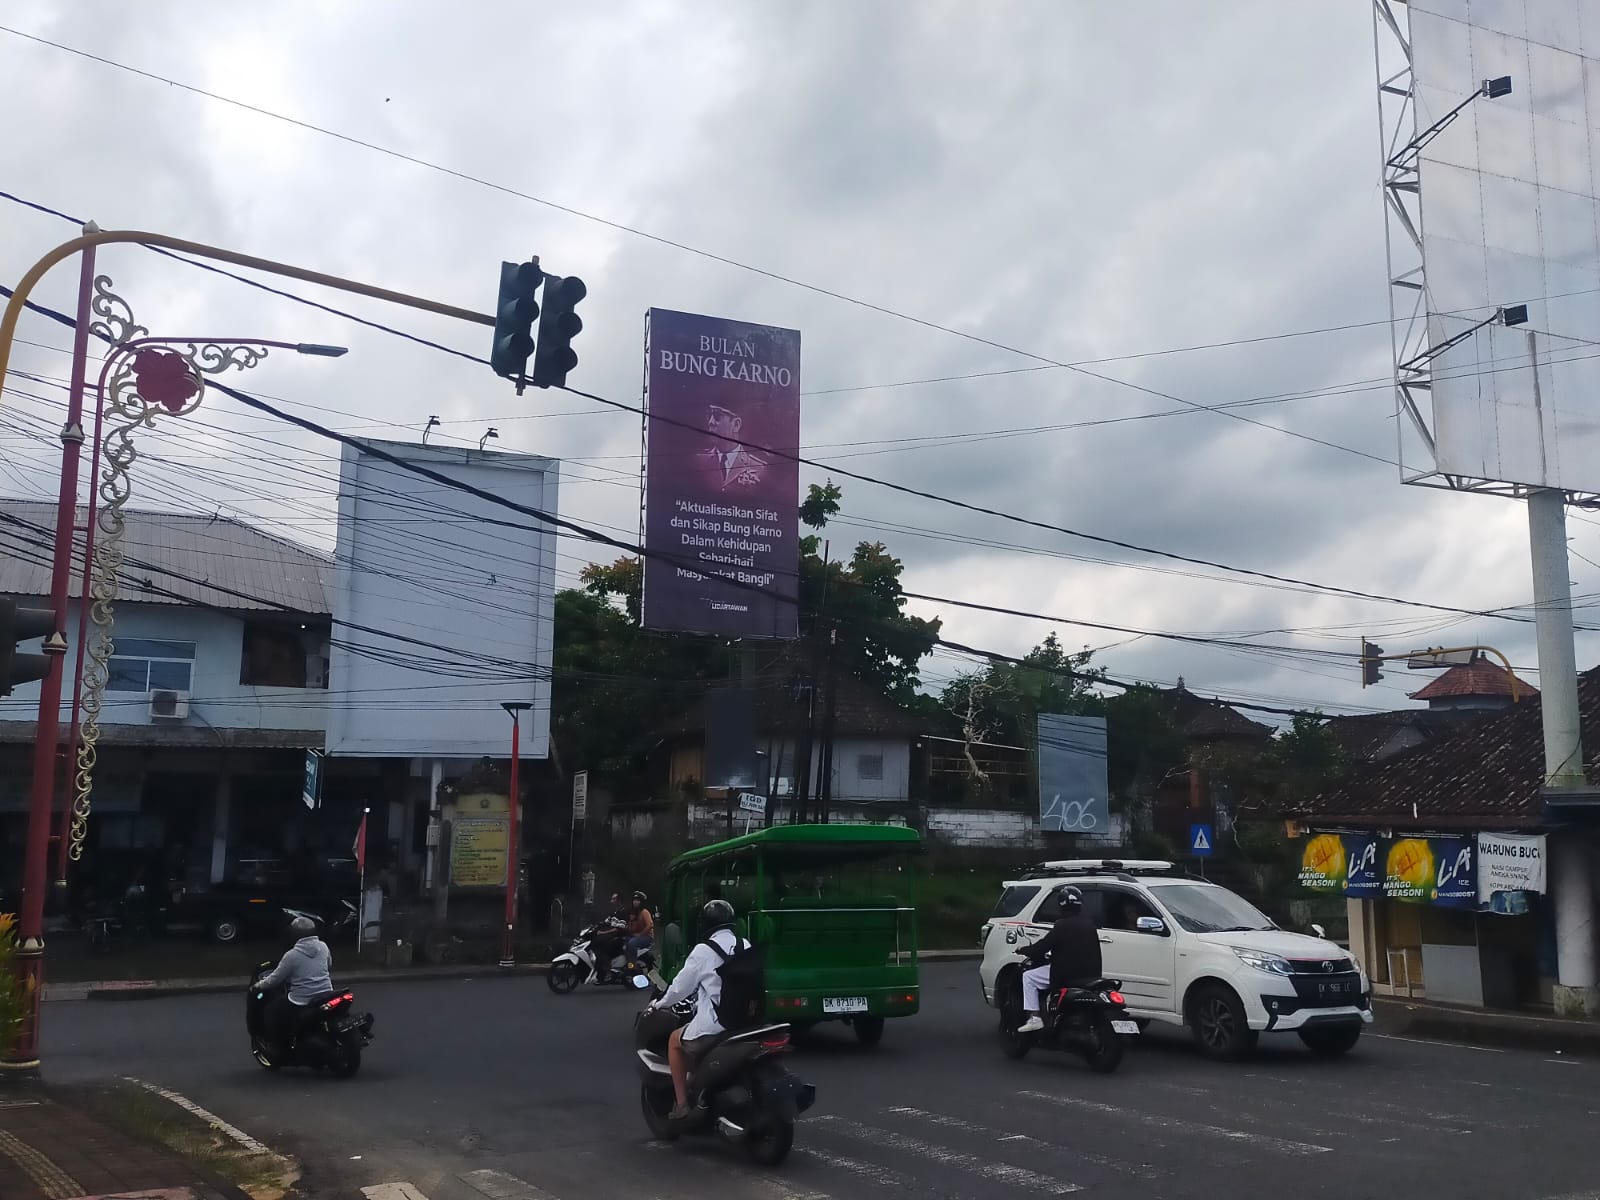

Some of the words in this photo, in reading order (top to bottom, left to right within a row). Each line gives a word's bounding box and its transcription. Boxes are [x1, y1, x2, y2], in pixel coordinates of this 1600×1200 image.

[700, 335, 756, 358] BULAN
[660, 350, 718, 377] BUNG
[722, 359, 791, 387] KARNO
[755, 508, 779, 522] Sifat
[670, 516, 691, 528] dan
[692, 518, 721, 533] Sikap
[723, 521, 750, 537] Bung
[752, 524, 782, 538] Karno
[681, 533, 715, 548] Dalam
[717, 537, 771, 553] Kehidupan
[1042, 792, 1097, 831] 406
[1479, 842, 1517, 858] WARUNG
[1297, 872, 1326, 880] MANGO
[1301, 879, 1337, 887] SEASON!
[1382, 881, 1411, 890] MANGO
[1386, 888, 1424, 897] SEASON!
[824, 998, 834, 1008] DK
[857, 997, 866, 1006] PA
